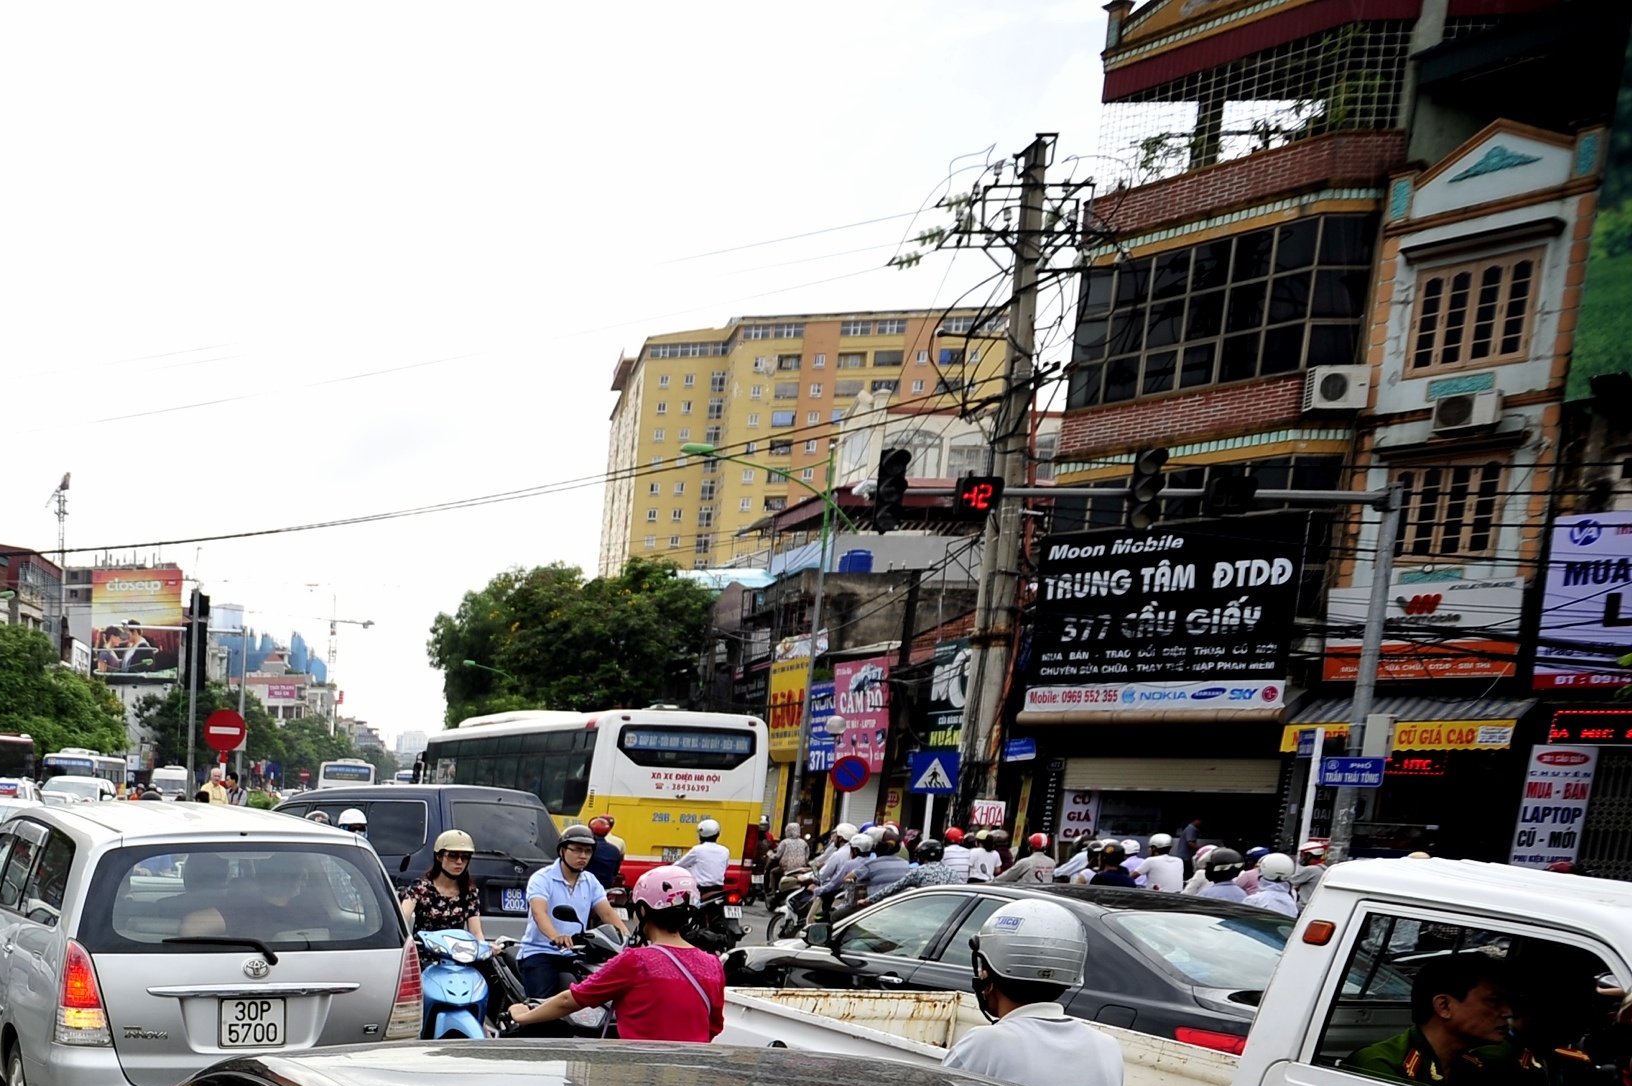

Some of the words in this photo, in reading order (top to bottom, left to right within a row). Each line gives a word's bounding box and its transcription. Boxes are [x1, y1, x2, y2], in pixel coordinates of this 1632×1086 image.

[1048, 544, 1106, 561] Moon
[1110, 535, 1184, 556] Mobile
[1045, 569, 1133, 601] TRUNG
[1140, 559, 1196, 593] TÂM
[1212, 558, 1293, 589] ĐTDĐ
[1562, 558, 1632, 587] MUA
[1185, 595, 1262, 635] GIẤY
[1041, 652, 1063, 661] MUA
[1068, 649, 1090, 660] BÁN
[1029, 690, 1060, 704] Mobile:
[1061, 690, 1083, 704] 0969
[1084, 690, 1100, 703] 552
[1102, 689, 1119, 703] 355
[1139, 690, 1188, 701] NOKIA
[1398, 724, 1416, 745] CŨ
[1419, 723, 1443, 744] GIÁ
[1446, 728, 1476, 744] CAO
[809, 750, 826, 771] 371
[1349, 760, 1373, 769] PHỐ
[663, 772, 673, 780] XE
[1526, 781, 1553, 800] MUA
[1562, 779, 1591, 800] BÁN
[1067, 809, 1092, 822] GIÁ
[1521, 806, 1584, 825] LAPTOP
[1063, 827, 1091, 839] CAO
[1517, 826, 1537, 848] CŨ
[1547, 827, 1579, 849] MỚI
[1513, 854, 1528, 864] PHỤ
[506, 888, 522, 899] 80B
[505, 899, 525, 910] 2002
[234, 1001, 272, 1021] 30P
[124, 1030, 168, 1039] INNOVA
[227, 1022, 278, 1044] 5700
